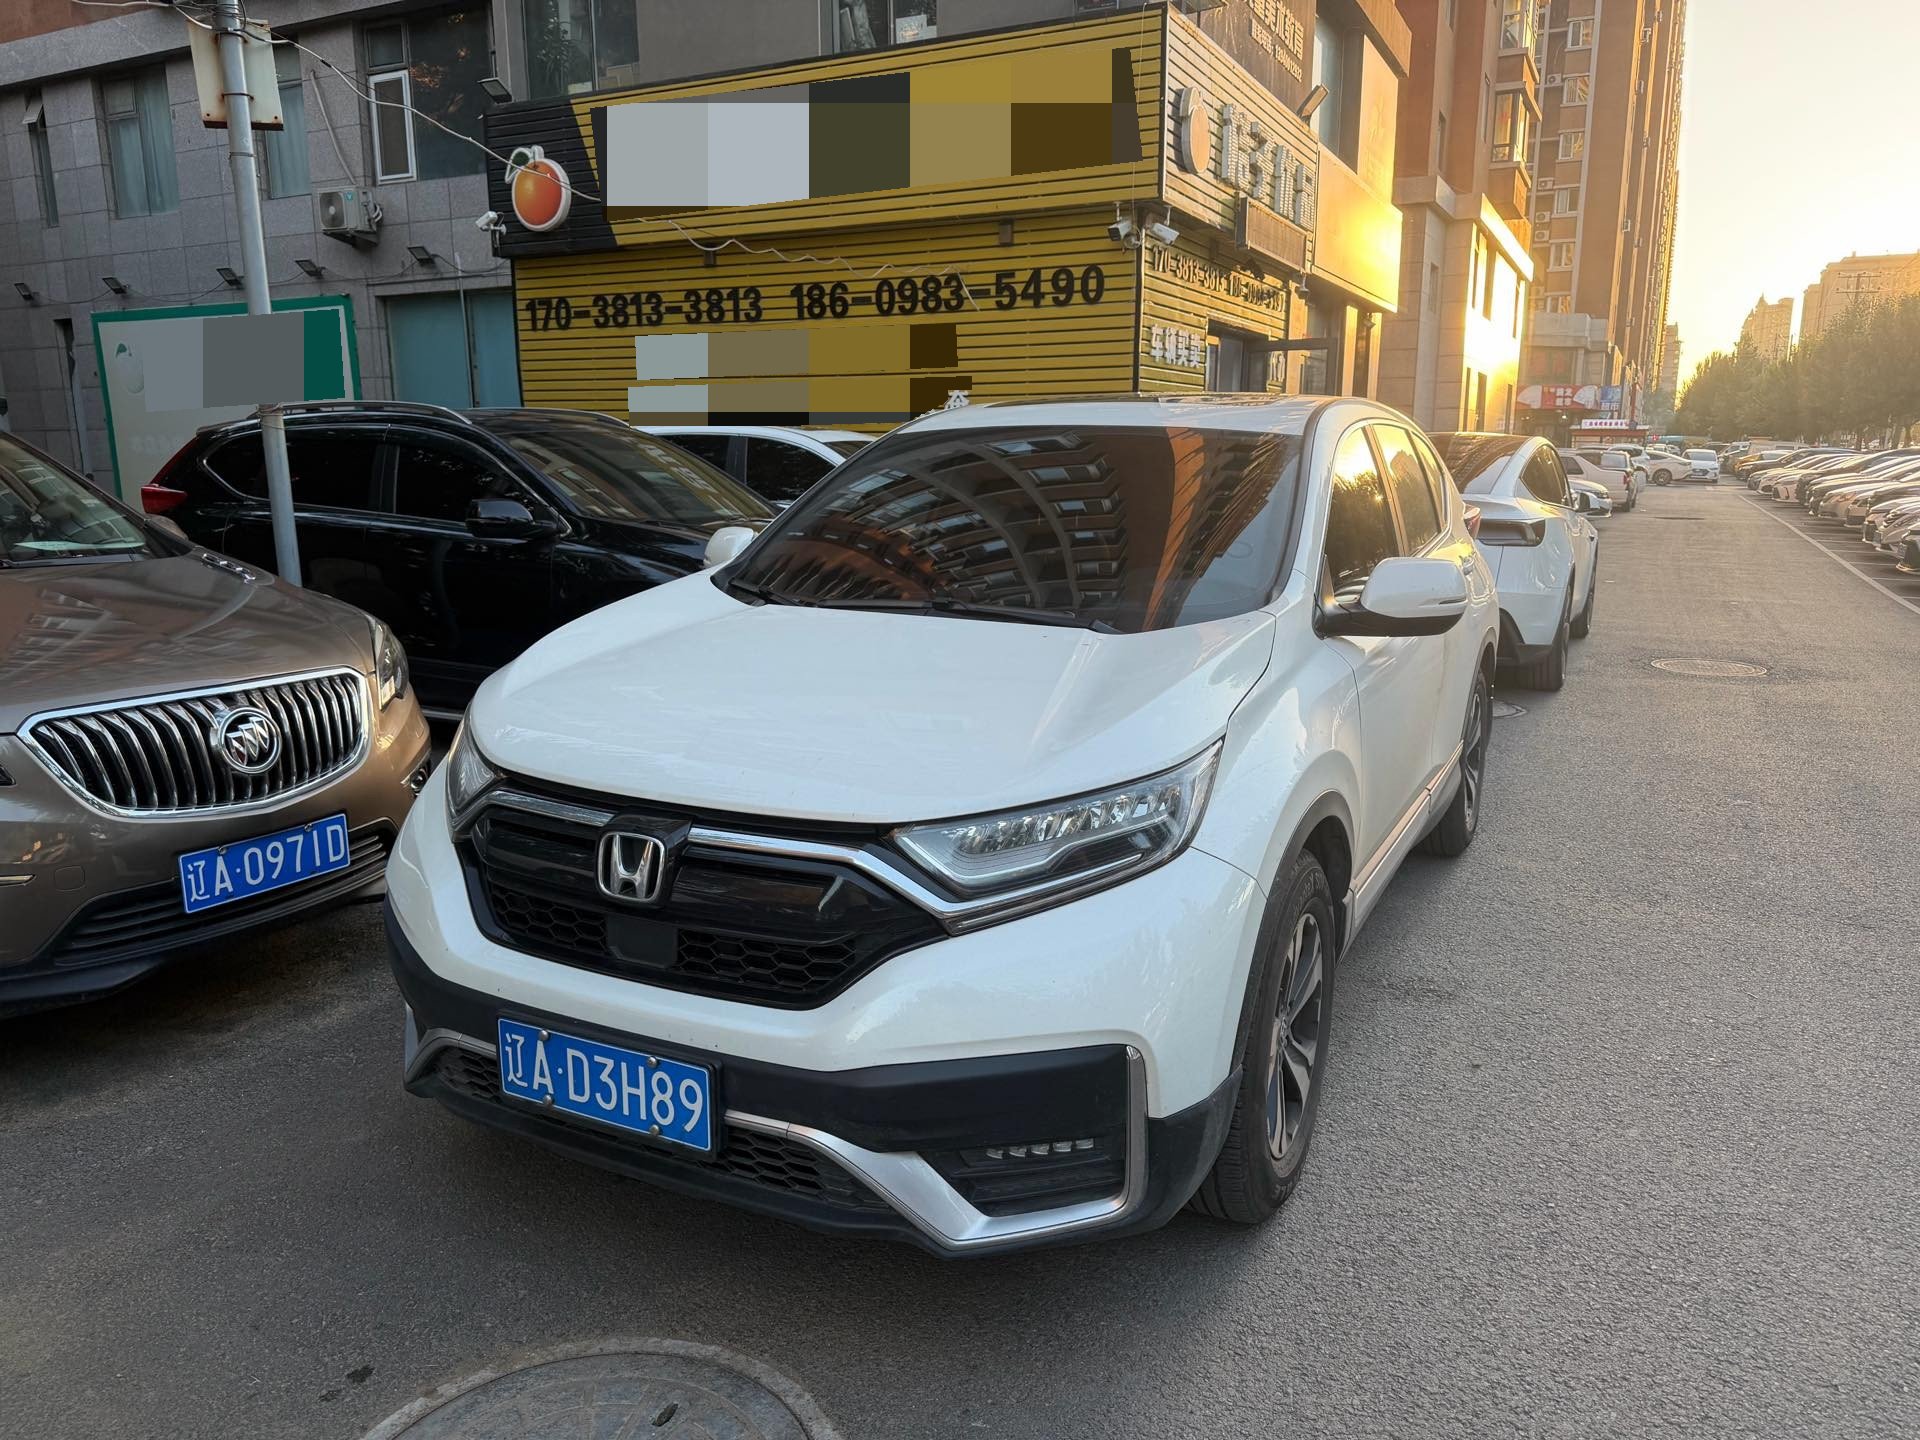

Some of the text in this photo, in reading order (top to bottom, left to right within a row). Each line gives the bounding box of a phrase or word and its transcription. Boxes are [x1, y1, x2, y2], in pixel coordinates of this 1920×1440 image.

[525, 264, 1105, 331] 170-3813-3813 186-0983-5490
[505, 1033, 703, 1133] 辽A·D3H89
